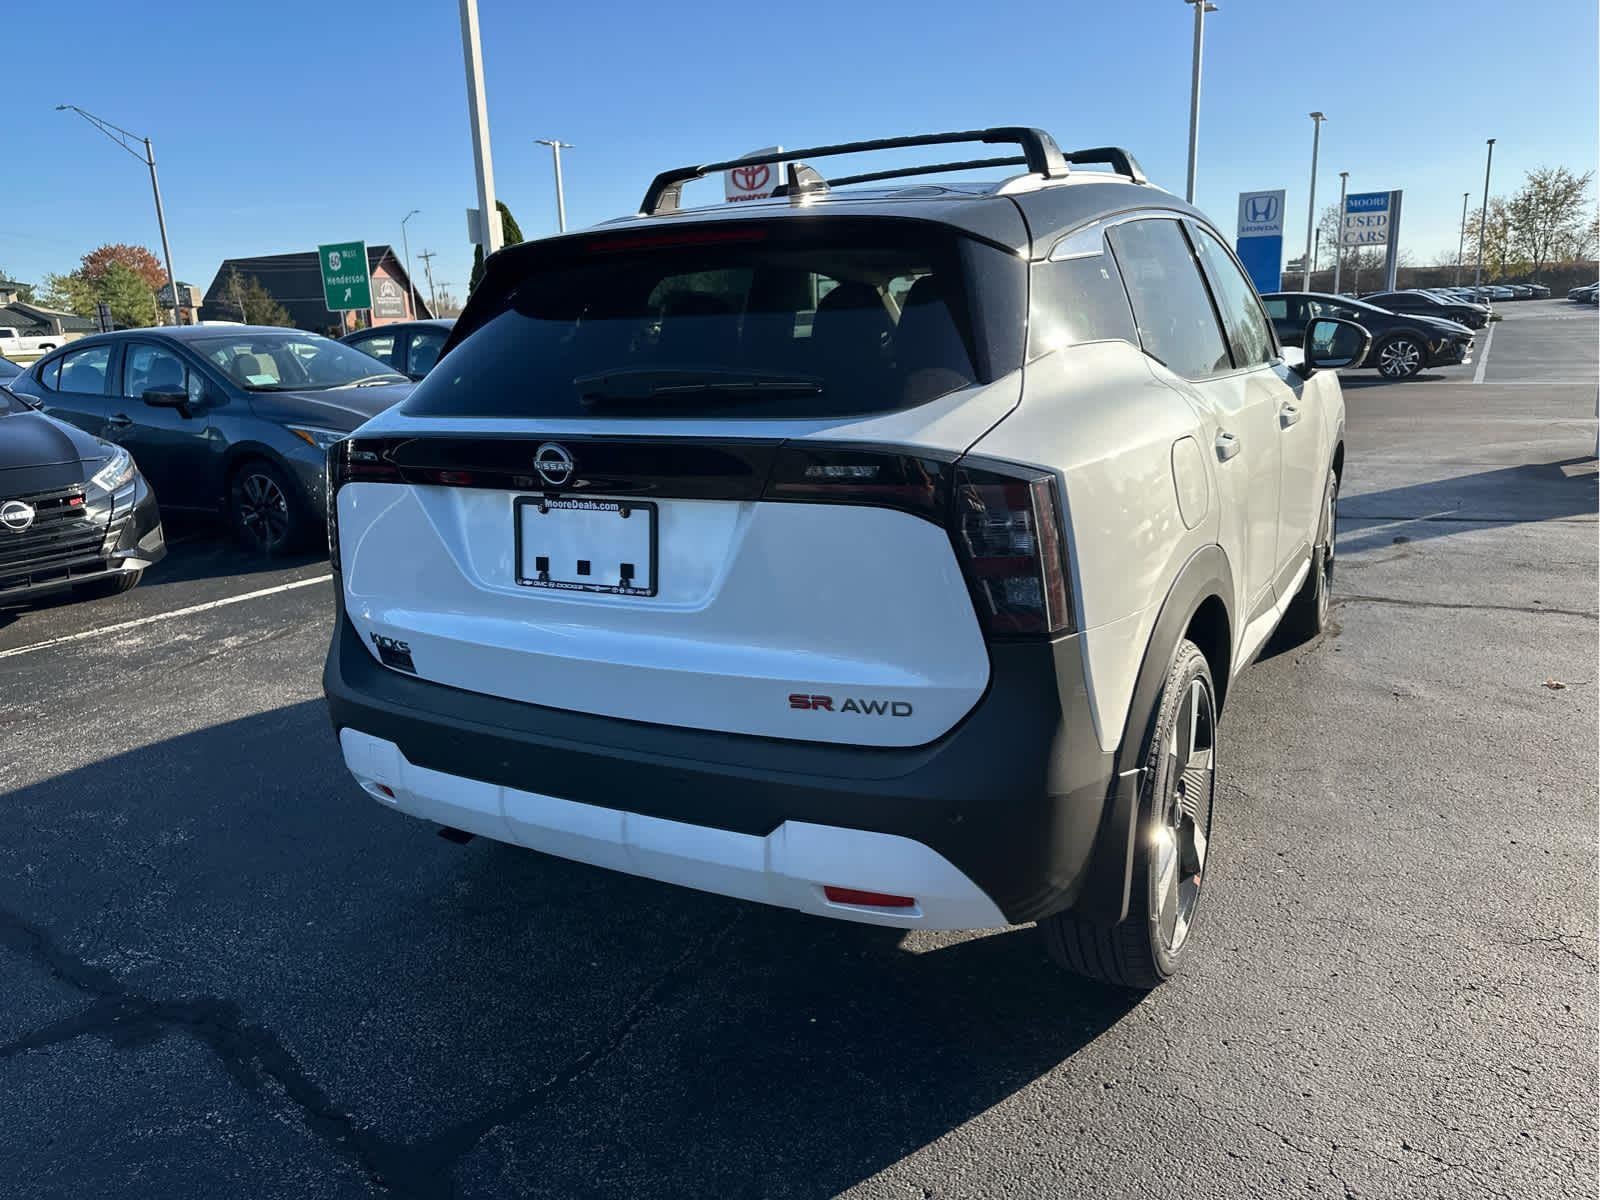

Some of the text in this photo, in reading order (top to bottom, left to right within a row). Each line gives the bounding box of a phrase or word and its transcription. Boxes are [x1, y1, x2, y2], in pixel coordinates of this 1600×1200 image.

[727, 193, 769, 202] TOYOT
[1348, 196, 1387, 207] MOORE
[1241, 224, 1280, 233] HONDA
[1346, 215, 1387, 229] USED
[1344, 231, 1386, 244] CARS
[327, 273, 365, 286] Henderson
[534, 461, 574, 472] NISSAN
[544, 498, 619, 512] MooreDeals.com
[788, 693, 913, 717] SR AWD
